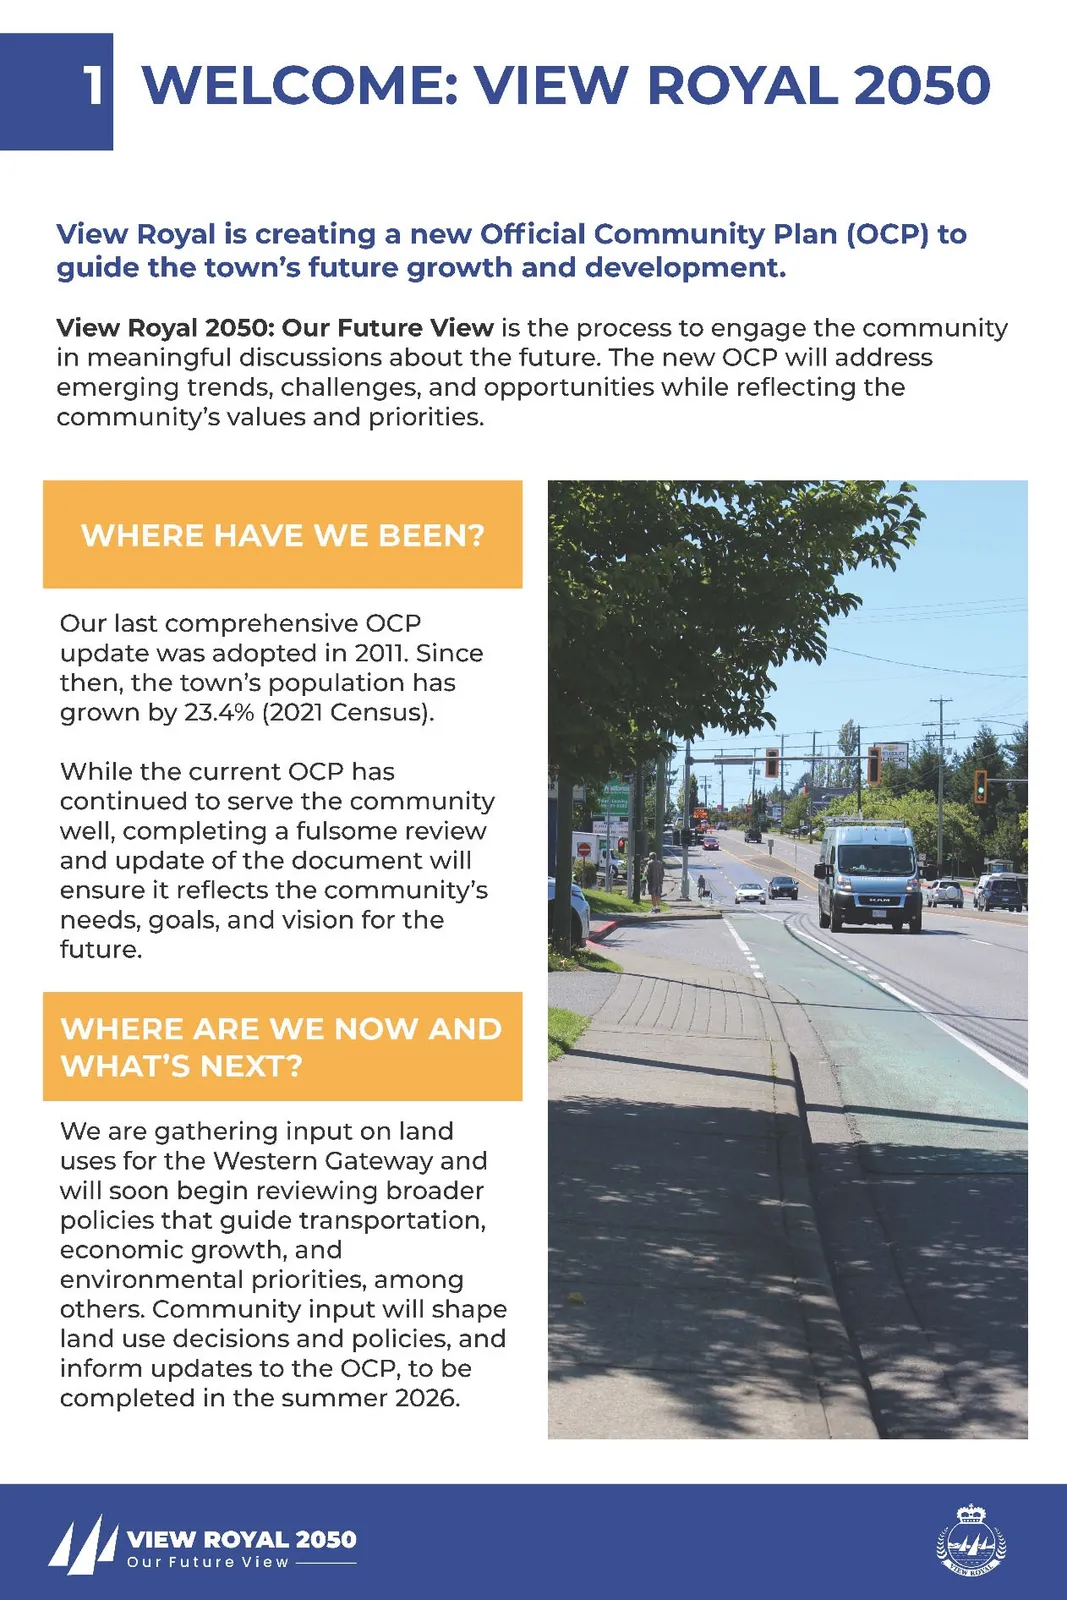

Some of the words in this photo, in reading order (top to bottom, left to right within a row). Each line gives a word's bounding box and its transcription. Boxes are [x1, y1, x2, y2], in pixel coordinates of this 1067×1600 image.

[82, 65, 102, 105] 1
[140, 64, 458, 106] WELCOME:
[472, 65, 630, 105] VIEW
[649, 64, 839, 106] ROYAL
[853, 64, 991, 106] 2050
[55, 220, 129, 245] View
[138, 222, 215, 250] Royal
[225, 220, 248, 245] is
[255, 220, 376, 250] creating
[384, 227, 401, 245] a
[411, 227, 473, 245] new
[480, 220, 585, 245] Official
[594, 220, 766, 250] Community
[774, 222, 837, 245] Plan
[847, 222, 929, 250] (OCP)
[937, 224, 968, 245] to
[56, 254, 140, 284] guide
[147, 255, 197, 279] the
[307, 255, 399, 279] future
[406, 255, 513, 284] growth
[521, 255, 576, 279] and
[585, 255, 787, 284] development.
[55, 316, 121, 338] View
[128, 317, 197, 343] Royal
[204, 318, 275, 338] 2050:
[281, 318, 331, 338] Our
[338, 318, 424, 338] Future
[429, 316, 495, 338] View
[502, 317, 521, 338] is
[527, 317, 569, 338] the
[577, 322, 672, 342] process
[678, 319, 705, 338] to
[711, 322, 807, 343] engage
[813, 317, 856, 338] the
[862, 317, 1009, 343] community
[57, 346, 79, 367] in
[88, 346, 231, 372] meaningful
[239, 346, 383, 367] discussions
[389, 346, 464, 367] about
[469, 346, 512, 367] the
[518, 346, 601, 367] future.
[608, 346, 655, 367] The
[663, 351, 716, 367] new
[722, 347, 778, 367] OCP
[784, 346, 827, 367] will
[835, 346, 934, 367] address
[56, 375, 179, 402] emerging
[187, 376, 274, 400] trends,
[280, 376, 422, 402] challenges,
[428, 376, 476, 397] and
[483, 375, 655, 402] opportunities
[660, 375, 729, 397] while
[737, 375, 856, 402] reflecting
[863, 376, 906, 397] the
[226, 406, 306, 427] values
[313, 406, 360, 427] and
[369, 406, 485, 432] priorities.
[80, 523, 204, 548] WHERE
[214, 523, 304, 548] HAVE
[313, 523, 369, 548] WE
[379, 523, 485, 548] BEEN?
[60, 613, 108, 633] Our
[115, 612, 158, 633] last
[165, 612, 359, 638] comprehensive
[366, 613, 422, 633] OCP
[61, 642, 150, 668] update
[156, 647, 206, 663] was
[212, 642, 316, 668] adopted
[325, 642, 347, 663] in
[354, 643, 409, 663] 2011.
[416, 642, 484, 663] Since
[59, 672, 124, 696] then,
[130, 672, 173, 693] the
[269, 671, 404, 697] population
[413, 672, 456, 693] has
[60, 706, 140, 727] grown
[149, 702, 178, 727] by
[184, 702, 255, 722] 23.4%
[263, 702, 322, 727] (2021
[330, 702, 435, 727] Census).
[60, 760, 133, 782] While
[139, 761, 182, 782] the
[188, 763, 282, 782] current
[288, 762, 344, 782] OCP
[352, 761, 395, 782] has
[59, 820, 116, 844] well,
[122, 819, 267, 846] completing
[274, 825, 289, 841] a
[296, 820, 398, 841] fulsome
[406, 819, 488, 841] review
[60, 884, 146, 900] ensure
[153, 879, 170, 900] it
[177, 879, 269, 900] reflects
[274, 879, 317, 900] the
[59, 938, 142, 959] future.
[60, 1017, 184, 1041] WHERE
[192, 1017, 260, 1041] ARE
[269, 1017, 325, 1041] WE
[335, 1016, 420, 1041] NOW
[427, 1017, 503, 1041] AND
[201, 1053, 303, 1078] NEXT?
[60, 1121, 101, 1141] We
[108, 1125, 147, 1141] are
[154, 1120, 278, 1146] gathering
[286, 1120, 354, 1145] input
[360, 1125, 391, 1141] on
[400, 1120, 453, 1141] land
[61, 1155, 117, 1171] uses
[122, 1150, 158, 1171] for
[163, 1150, 206, 1171] the
[213, 1151, 317, 1171] Western
[324, 1151, 434, 1176] Gateway
[440, 1150, 487, 1171] and
[61, 1209, 155, 1235] policies
[160, 1209, 213, 1230] that
[220, 1209, 292, 1235] guide
[298, 1209, 486, 1235] transportation,
[60, 1239, 184, 1259] economic
[191, 1239, 288, 1265] growth,
[295, 1239, 342, 1260] and
[60, 1268, 243, 1289] environmental
[252, 1268, 367, 1294] priorities,
[374, 1273, 464, 1294] among
[60, 1357, 142, 1378] inform
[151, 1358, 253, 1383] updates
[258, 1360, 285, 1378] to
[291, 1358, 333, 1378] the
[340, 1358, 401, 1381] OCP,
[407, 1360, 434, 1378] to
[441, 1358, 472, 1378] be
[60, 1387, 195, 1413] completed
[203, 1387, 225, 1408] in
[232, 1387, 275, 1407] the
[281, 1392, 388, 1408] summer
[395, 1387, 460, 1408] 2026.
[126, 1530, 197, 1549] VIEW
[203, 1530, 290, 1549] ROYAL
[295, 1529, 357, 1549] 2050
[127, 1556, 162, 1568] Our
[169, 1556, 235, 1568] Future
[241, 1555, 289, 1568] View
[950, 1562, 968, 1576] VIEW
[970, 1564, 994, 1576] ROYAL
